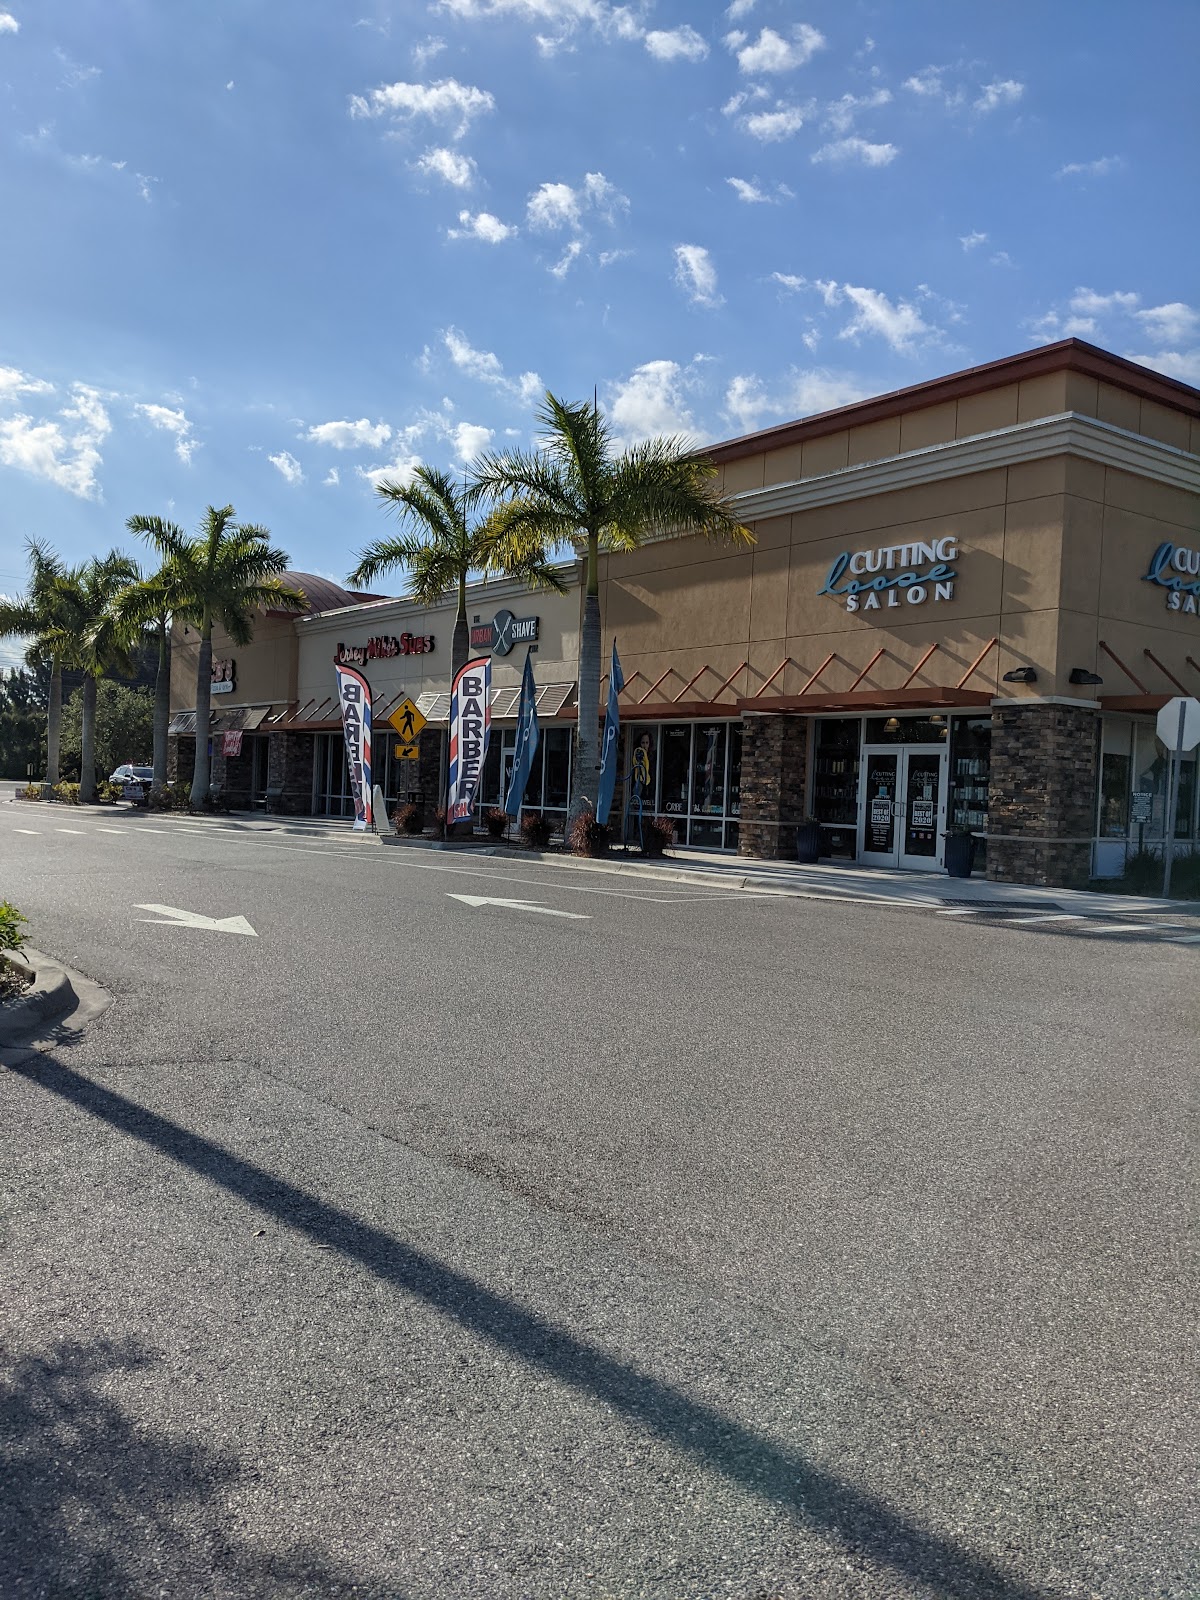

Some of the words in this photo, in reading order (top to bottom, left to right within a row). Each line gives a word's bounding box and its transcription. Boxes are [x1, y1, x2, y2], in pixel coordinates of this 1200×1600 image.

[850, 537, 959, 575] CUTTING
[816, 552, 957, 596] loose
[847, 582, 954, 612] SALON
[1167, 591, 1200, 615] SA
[472, 627, 493, 644] URBAN
[512, 620, 536, 639] SHAVE
[334, 642, 367, 667] Jersey
[459, 676, 483, 800] BARBER
